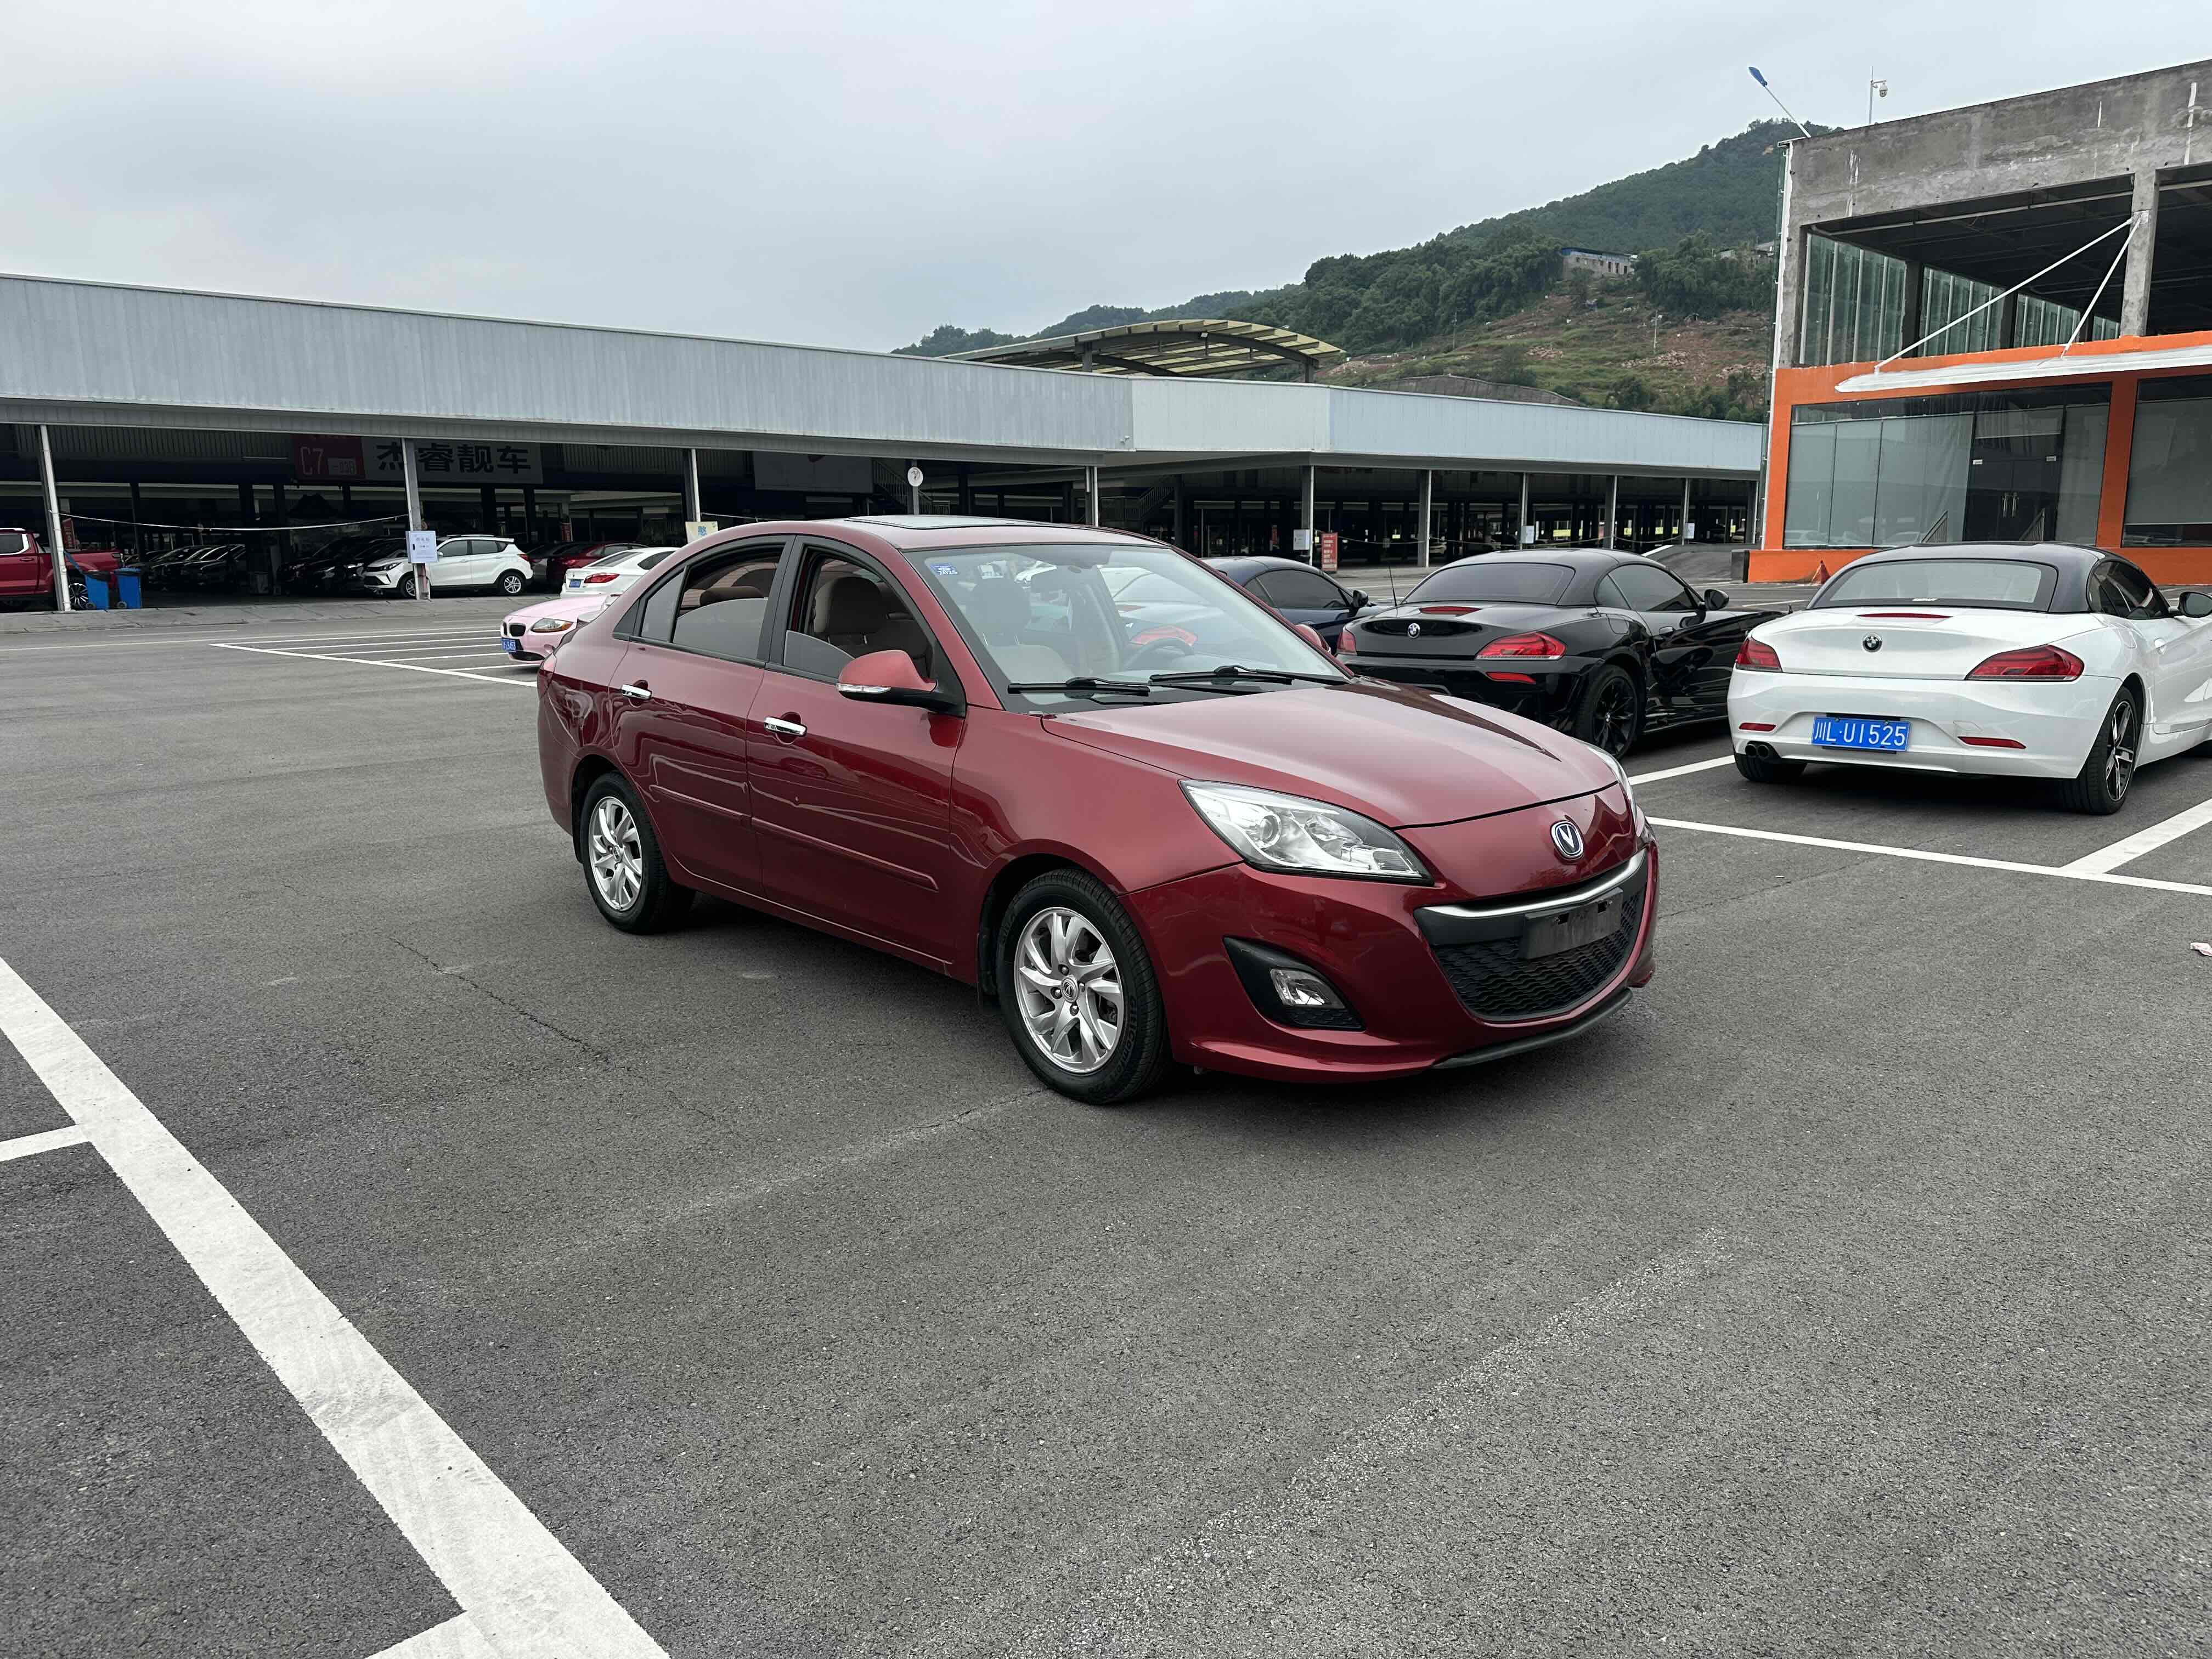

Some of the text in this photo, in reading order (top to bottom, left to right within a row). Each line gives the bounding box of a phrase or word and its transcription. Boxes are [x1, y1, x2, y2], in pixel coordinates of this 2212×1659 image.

[300, 446, 324, 475] C7
[377, 442, 531, 473] 杰睿靓车
